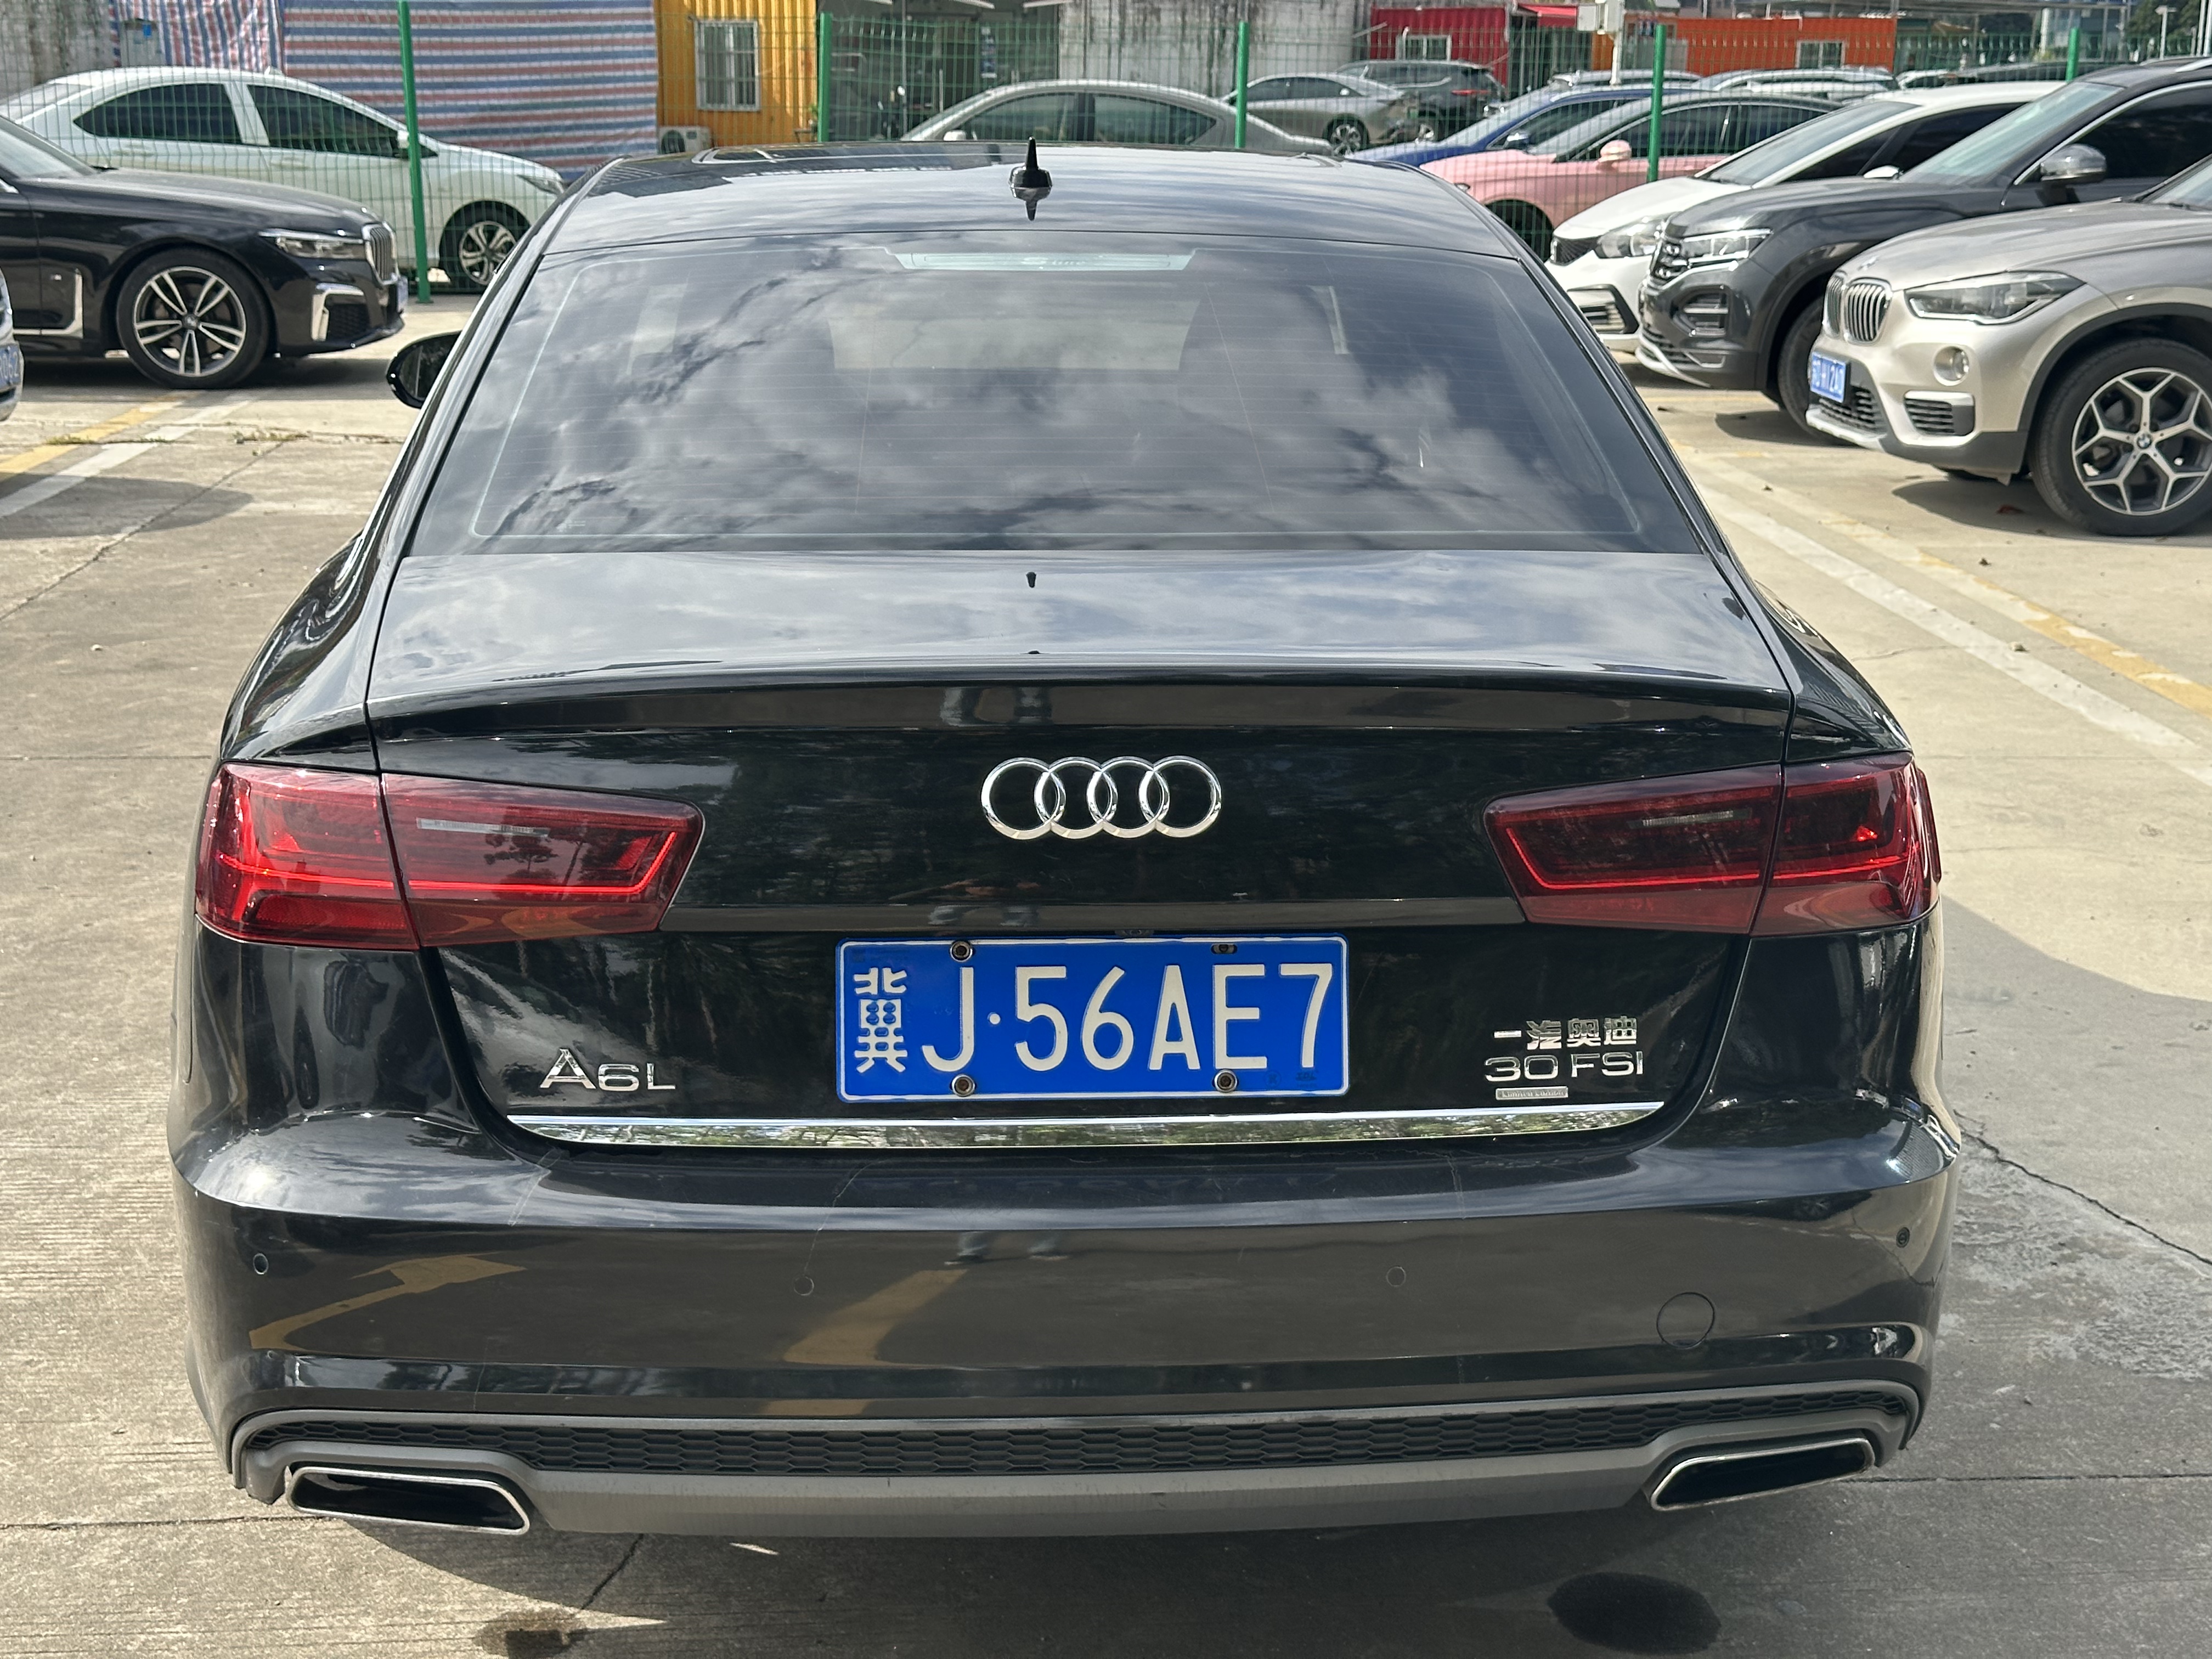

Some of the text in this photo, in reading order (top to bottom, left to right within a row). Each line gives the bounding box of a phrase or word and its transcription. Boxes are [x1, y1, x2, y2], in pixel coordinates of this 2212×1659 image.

[1493, 1015, 1637, 1050] 一汽奥迪
[540, 1048, 676, 1091] A6L
[1485, 1051, 1643, 1082] 30 FSI
